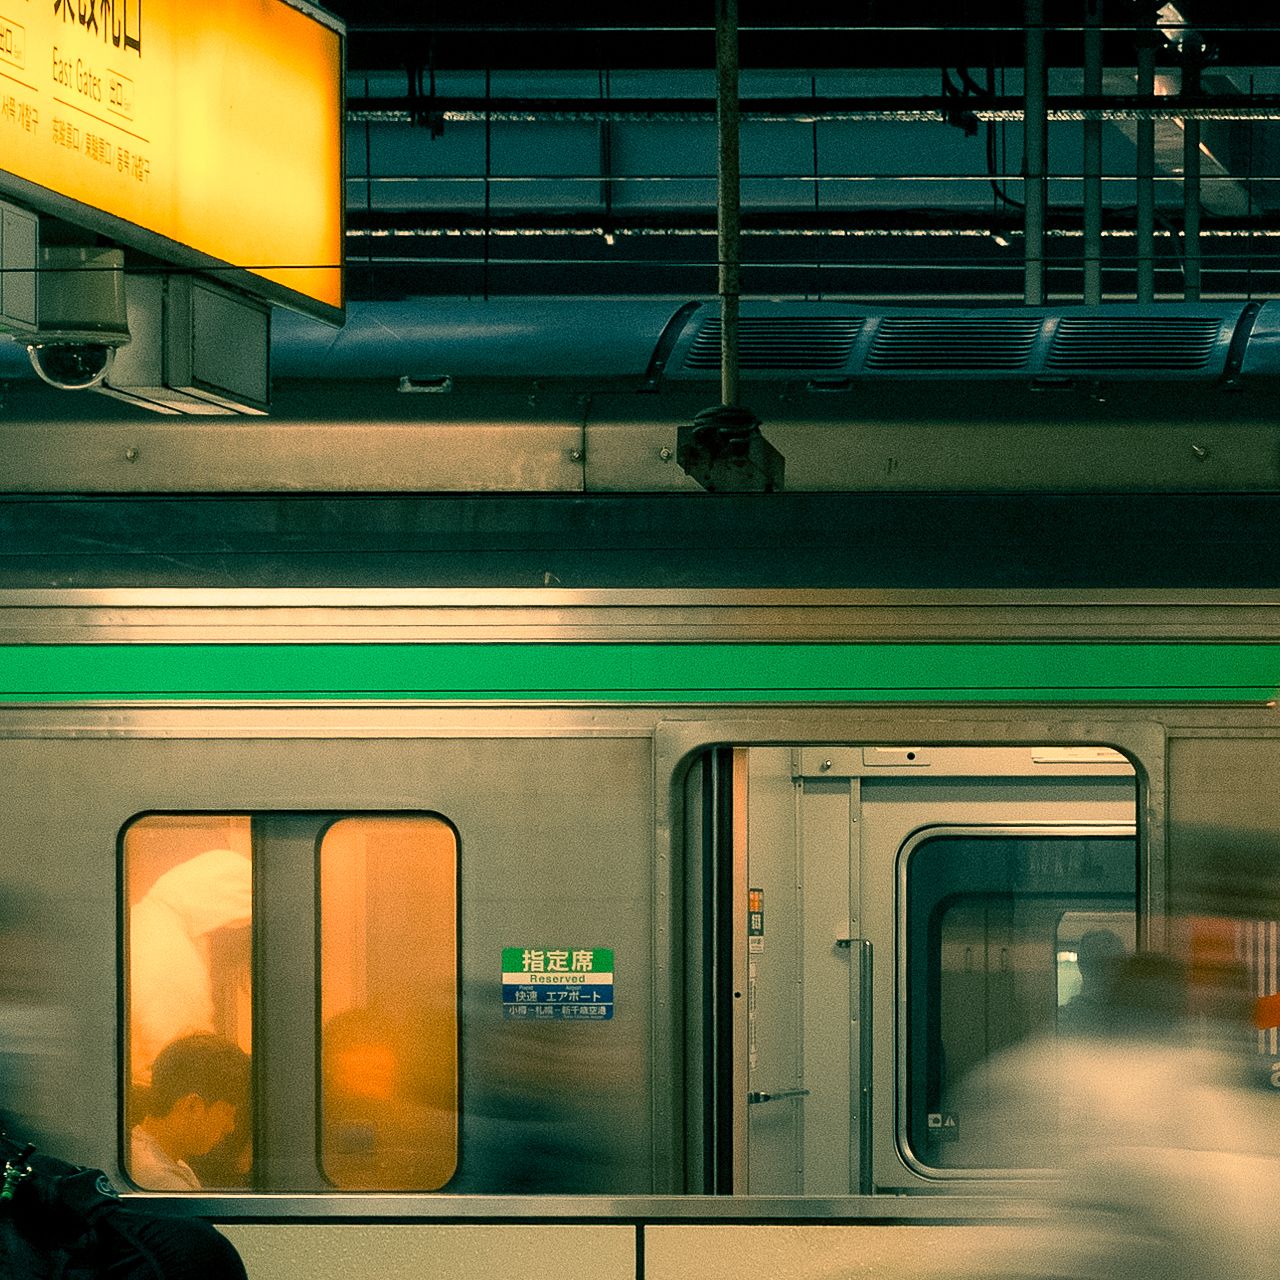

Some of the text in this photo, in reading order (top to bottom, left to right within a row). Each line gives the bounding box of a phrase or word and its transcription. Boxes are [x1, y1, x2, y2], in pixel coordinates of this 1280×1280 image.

[53, 46, 101, 102] East Gates
[522, 950, 593, 972] 指定席
[530, 975, 586, 983] Reserved
[515, 991, 601, 1002] 快速 エアポート
